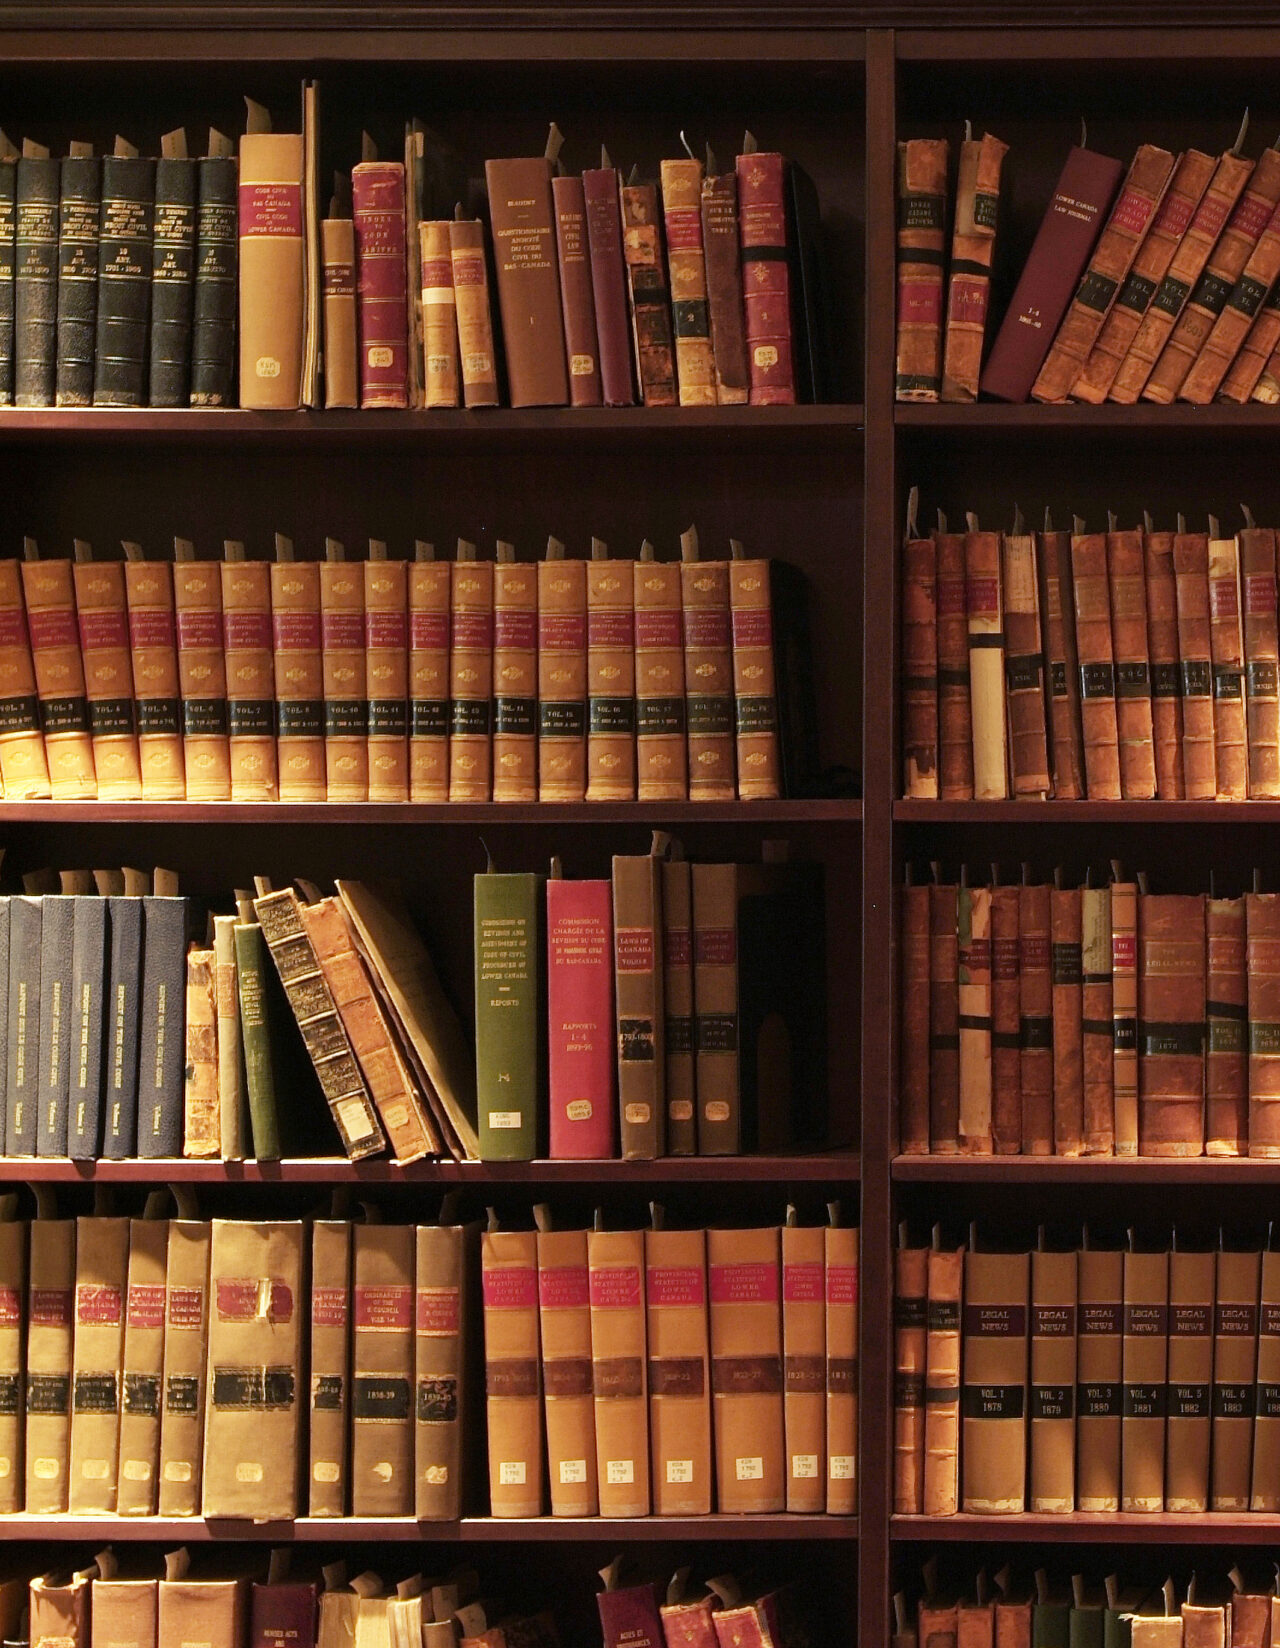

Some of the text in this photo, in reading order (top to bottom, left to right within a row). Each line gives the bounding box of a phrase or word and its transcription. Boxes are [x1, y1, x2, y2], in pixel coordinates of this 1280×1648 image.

[1056, 194, 1098, 213] LOWER CANADA
[1054, 205, 1092, 222] LAW JOURNAL
[981, 1311, 1009, 1319] LEGAL
[1039, 1311, 1068, 1319] LEGAL
[1085, 1310, 1114, 1318] LEGAL
[1131, 1310, 1160, 1318] LEGAL
[1177, 1310, 1205, 1318] LEGAL
[1222, 1310, 1250, 1318] LEGAL
[1178, 1323, 1205, 1331] NEWS
